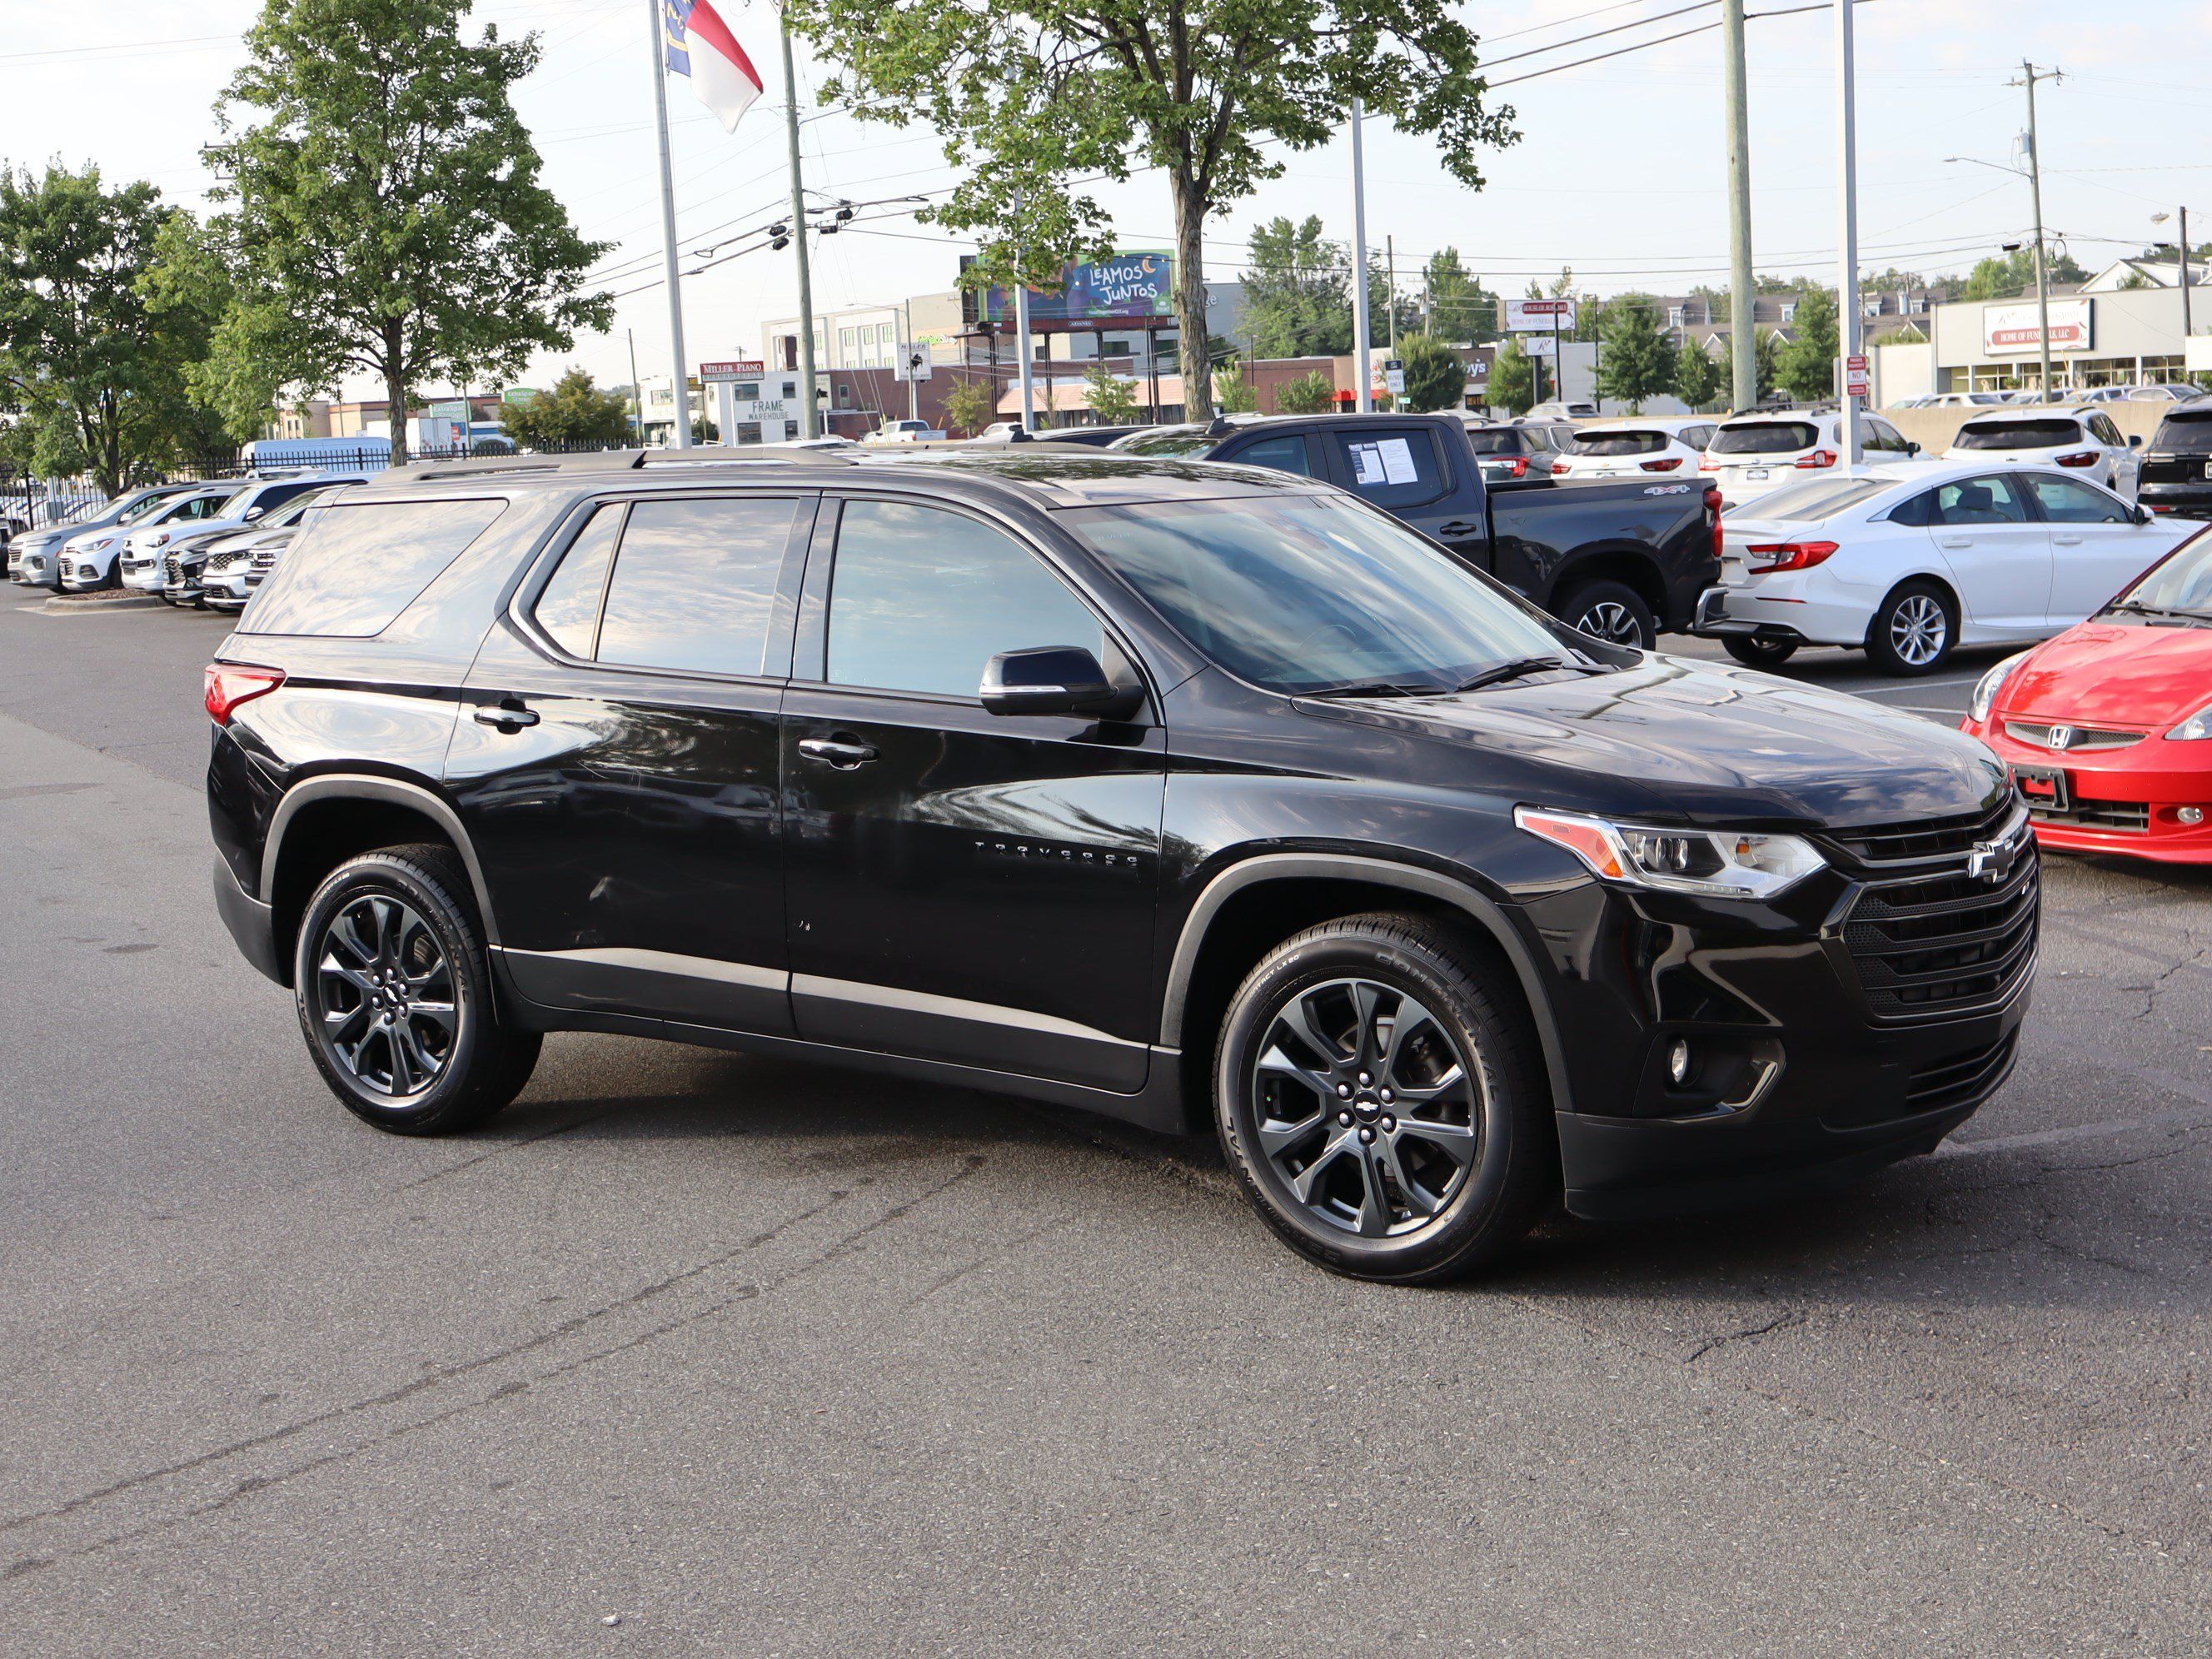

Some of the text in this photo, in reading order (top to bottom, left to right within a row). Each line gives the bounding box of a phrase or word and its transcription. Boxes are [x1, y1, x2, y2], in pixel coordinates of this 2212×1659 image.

[1089, 266, 1143, 286] LEAMOS
[2000, 331, 2017, 341] HOME
[2018, 331, 2025, 341] OF
[2058, 328, 2070, 338] LLC
[704, 363, 761, 374] MILLER PIANO
[752, 401, 783, 413] FRAME
[748, 411, 790, 421] WAREHOUSE
[974, 841, 1138, 868] TRAVERSE
